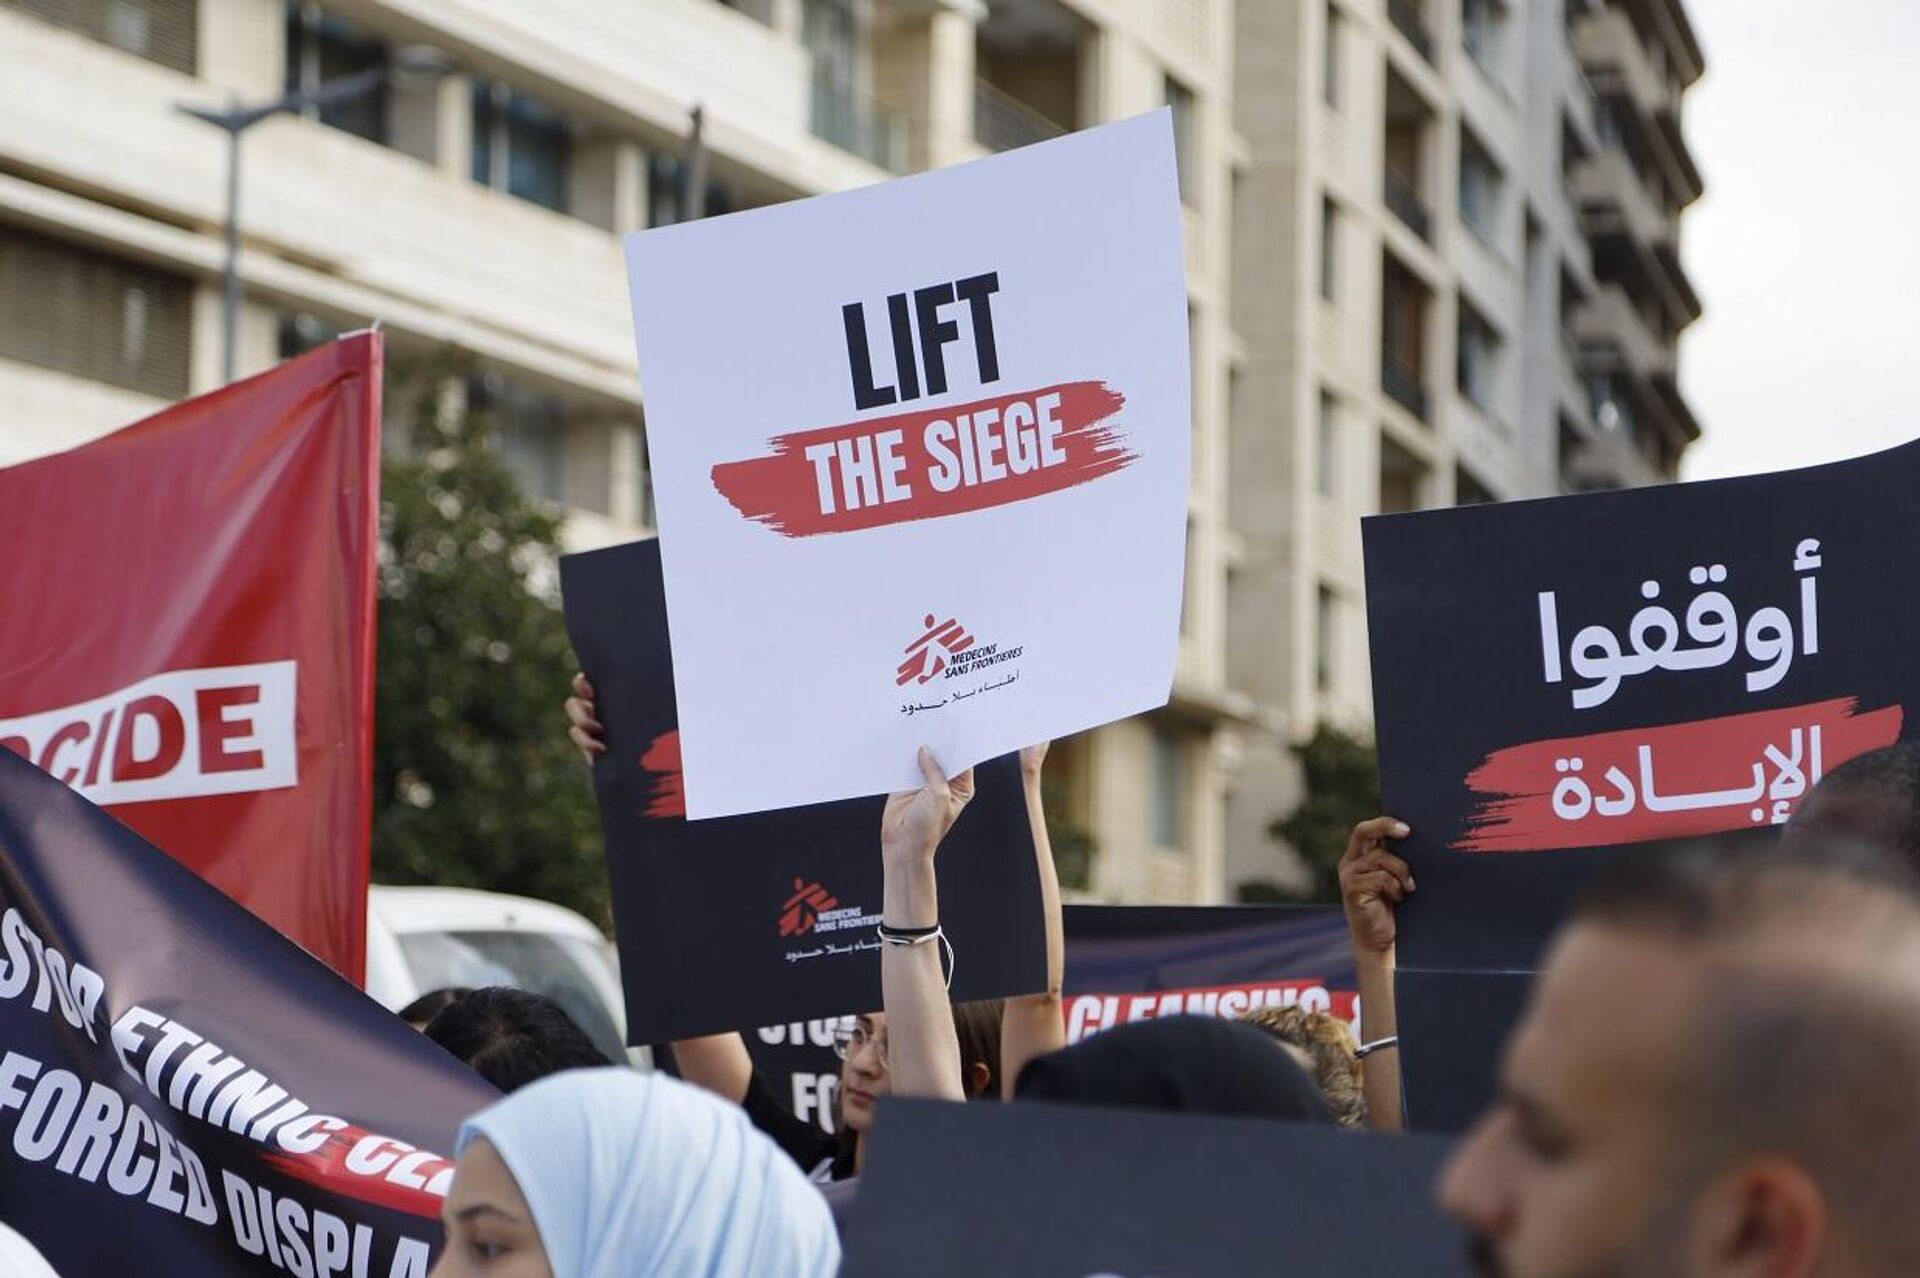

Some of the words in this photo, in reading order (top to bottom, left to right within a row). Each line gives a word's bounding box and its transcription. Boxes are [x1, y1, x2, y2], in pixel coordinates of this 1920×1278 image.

[842, 271, 1000, 411] LIFT
[806, 429, 912, 515] THE
[923, 392, 1067, 493] SIEGE
[945, 664, 969, 679] SANS
[971, 646, 1023, 671] FRONTIERES
[951, 644, 997, 665] MEDECINS
[1538, 538, 1822, 710] أوقفوا
[900, 698, 949, 716] حدود
[1552, 725, 1822, 825] الإبادة
[814, 921, 837, 932] SANS
[0, 908, 105, 1044] STOP
[111, 1005, 348, 1154] ETHNIC
[0, 1051, 218, 1226] FORCED
